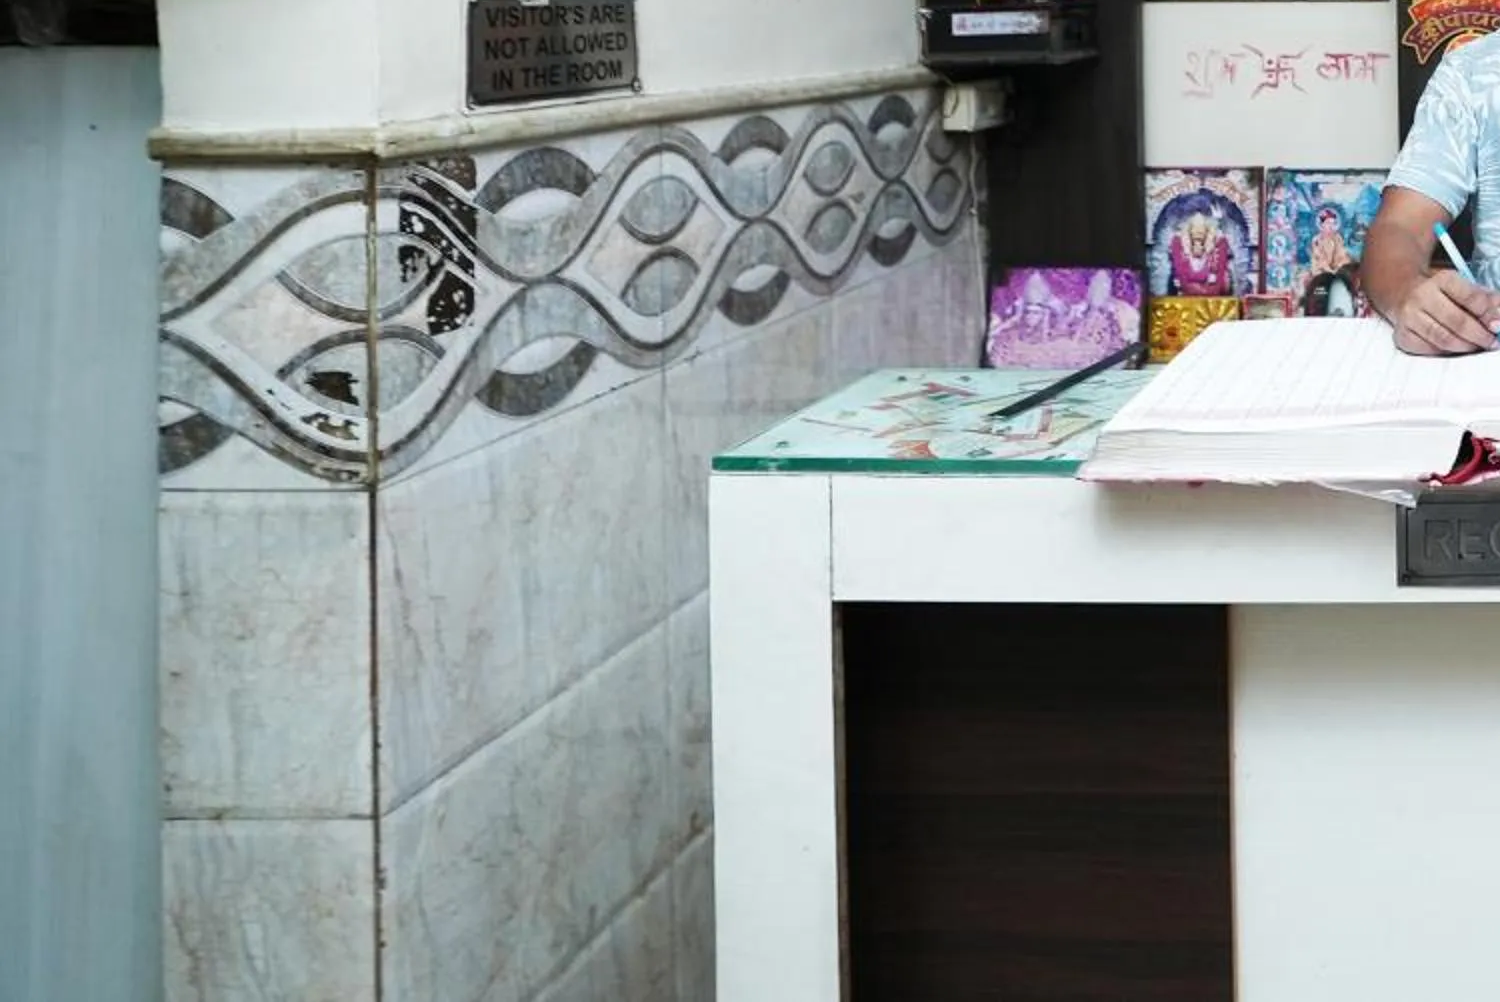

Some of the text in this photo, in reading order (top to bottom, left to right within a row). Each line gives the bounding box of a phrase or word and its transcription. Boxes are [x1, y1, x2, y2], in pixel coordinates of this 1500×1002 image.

[485, 3, 626, 28] VISITOR'S ARE
[485, 32, 628, 61] NOT ALLOWED
[492, 58, 623, 92] IN THE ROOM
